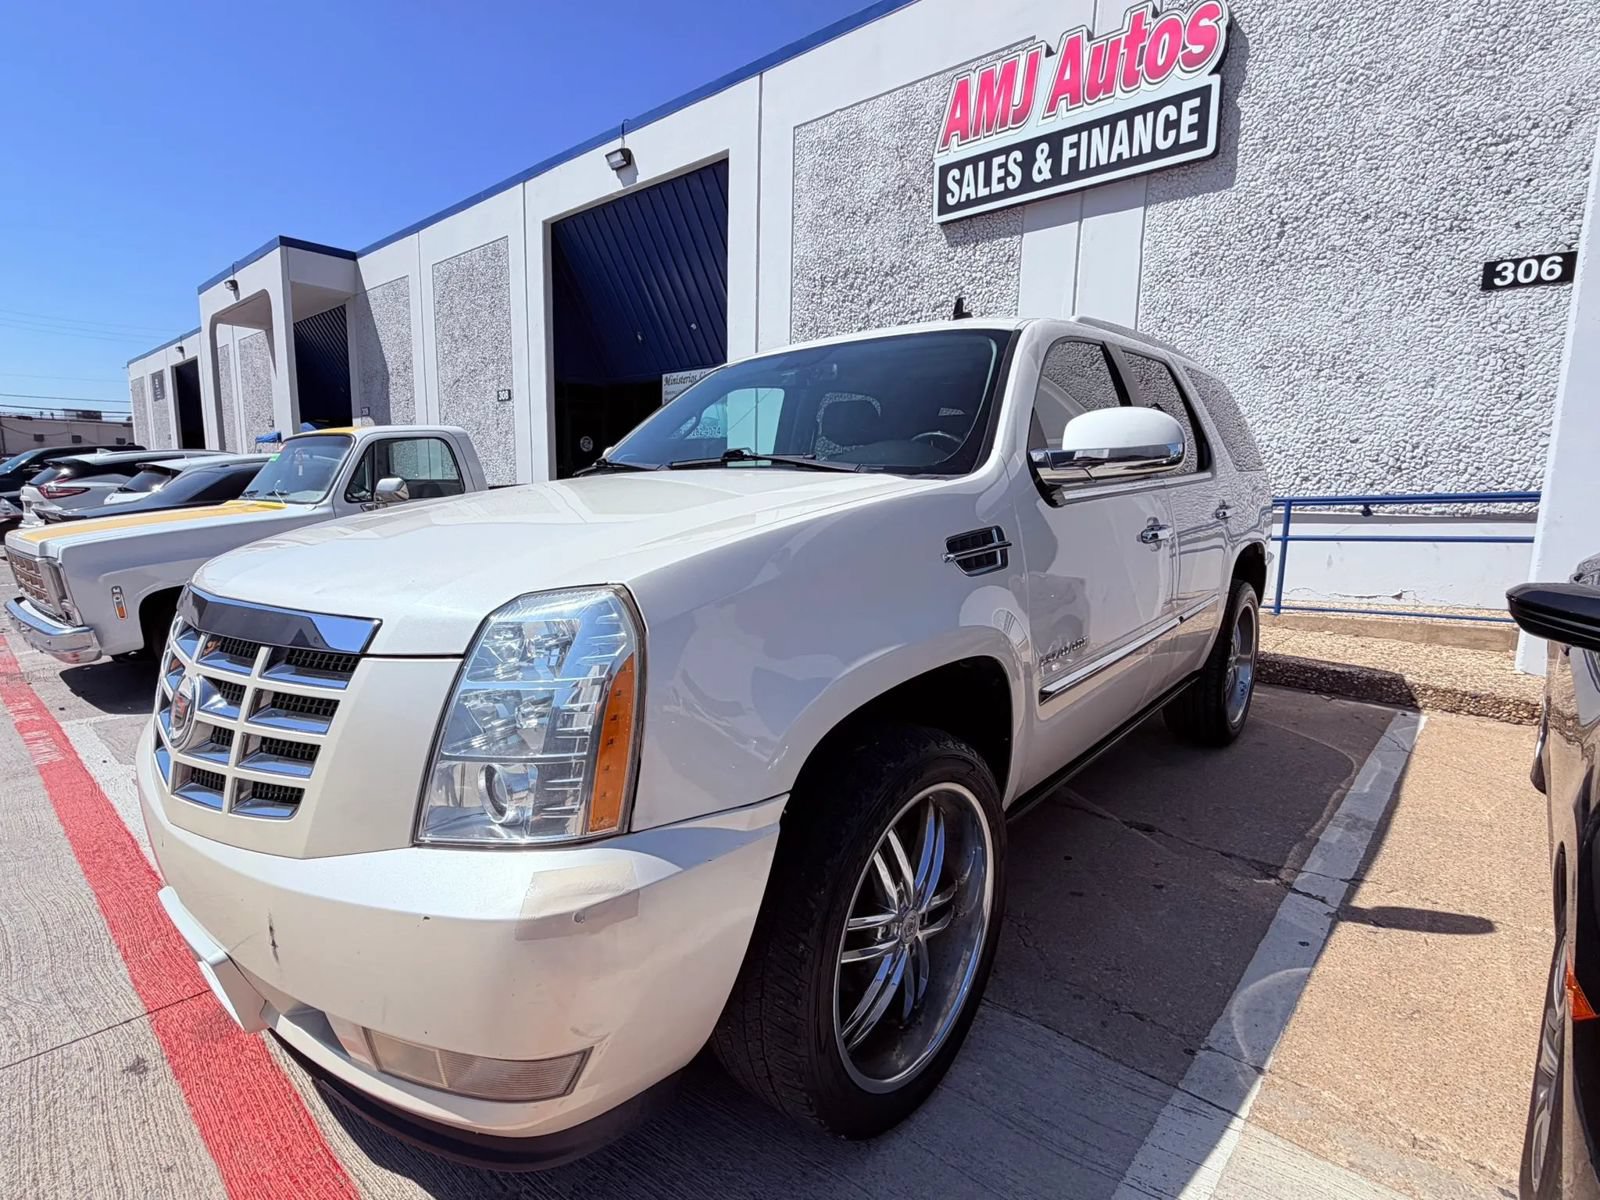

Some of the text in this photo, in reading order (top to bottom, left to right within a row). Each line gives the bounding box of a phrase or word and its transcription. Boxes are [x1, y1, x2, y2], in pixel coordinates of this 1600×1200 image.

[940, 2, 1224, 148] AMJ Autos
[946, 97, 1201, 206] SALES & FINANCE
[1493, 255, 1563, 286] 306
